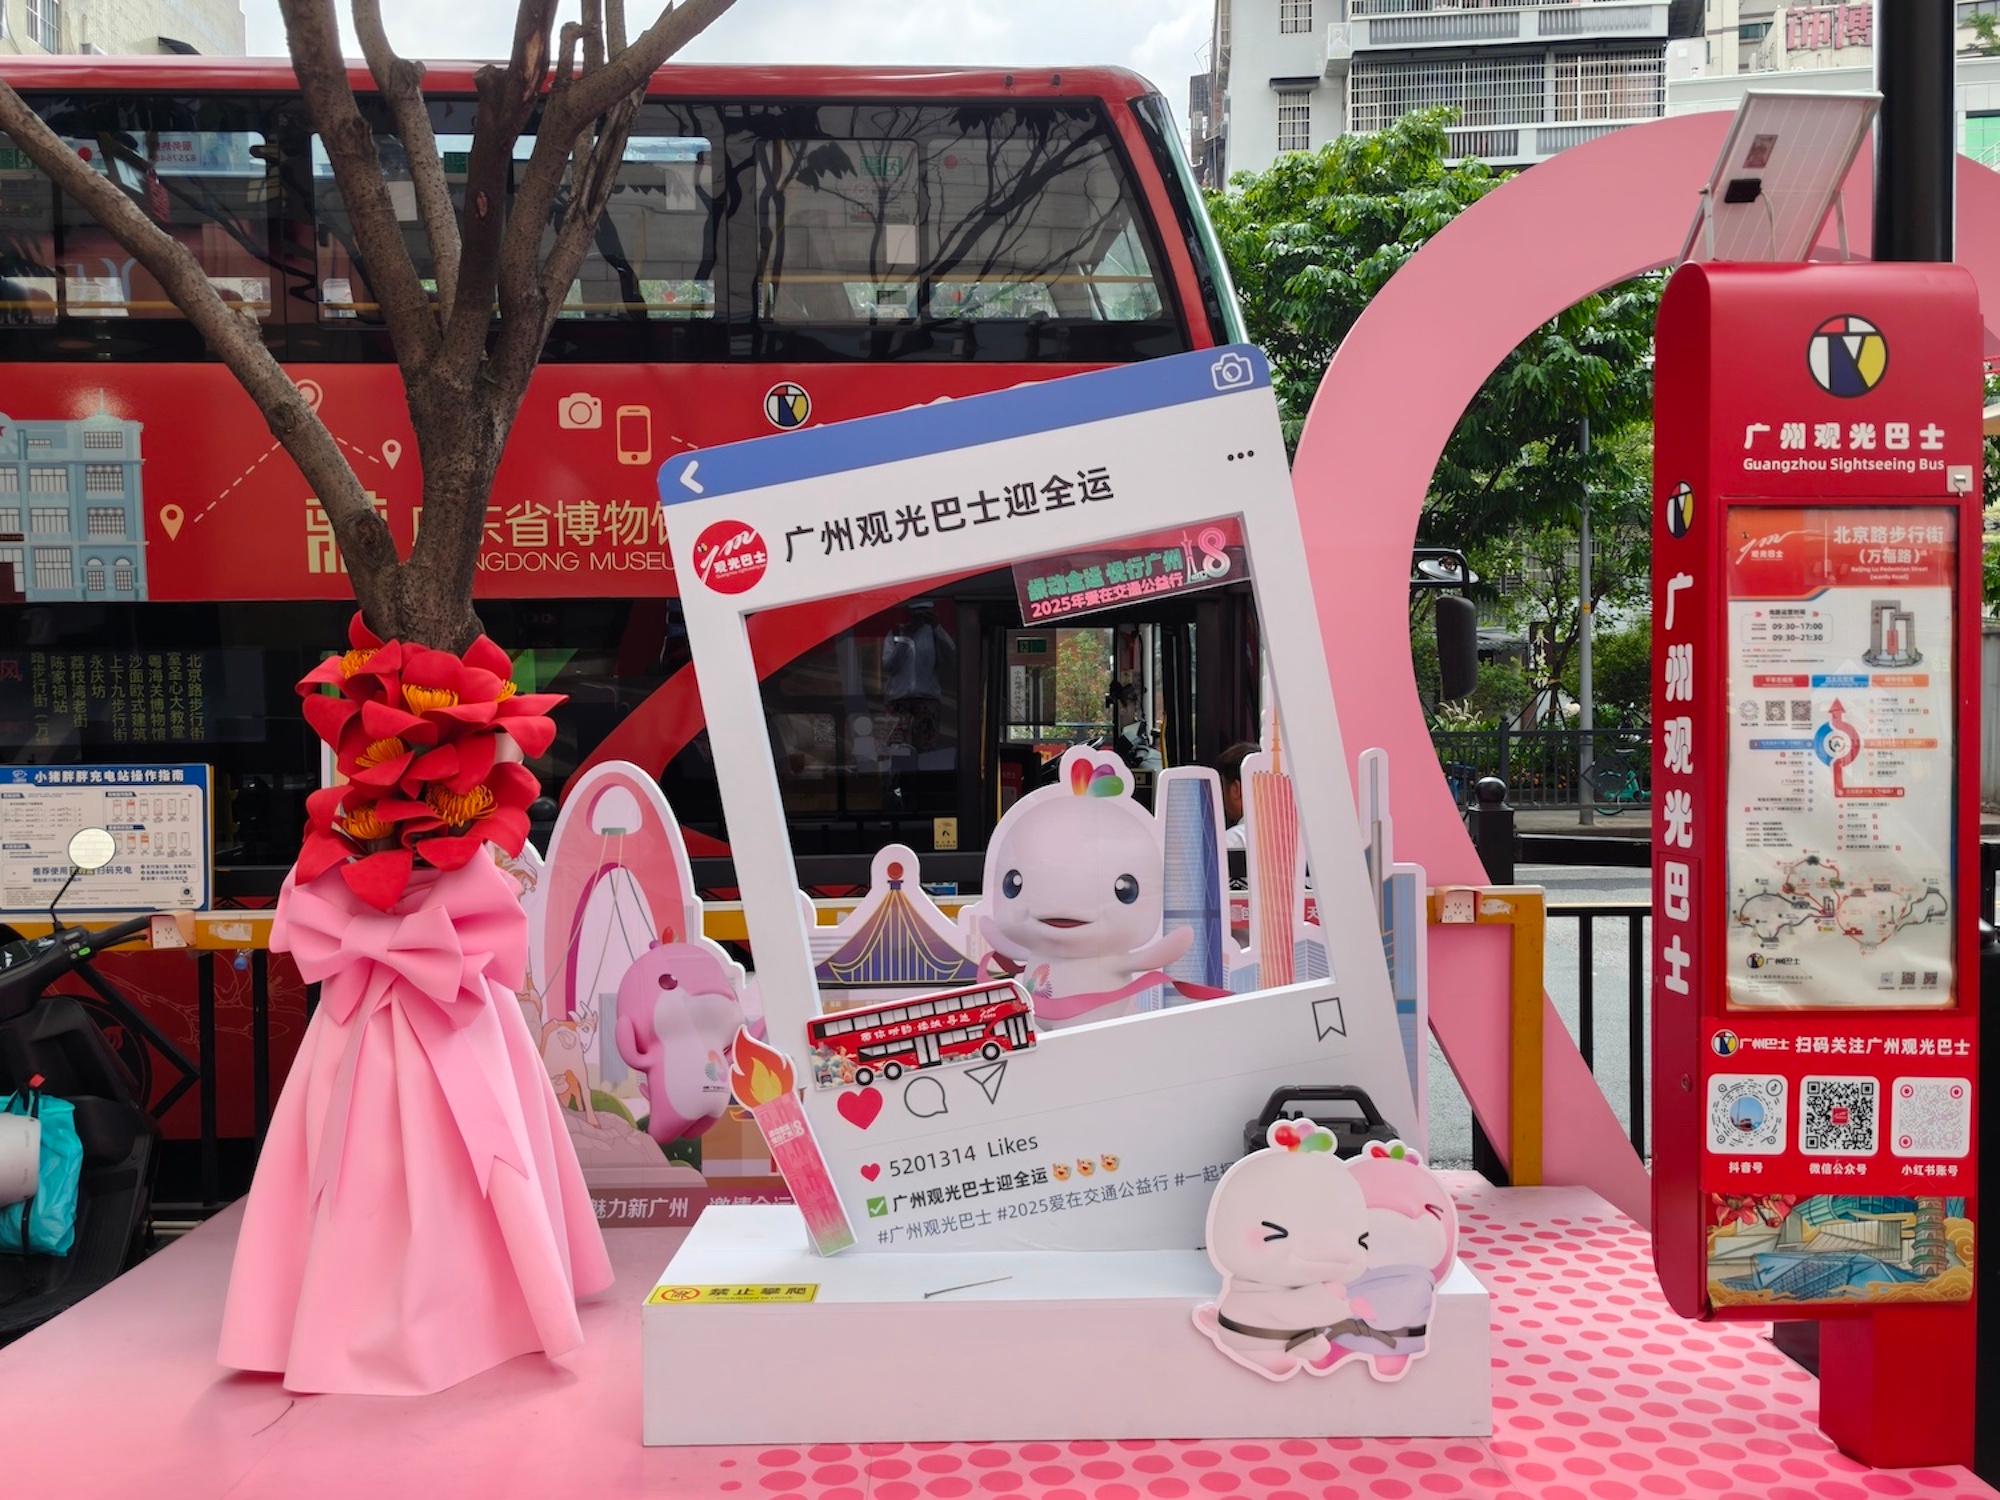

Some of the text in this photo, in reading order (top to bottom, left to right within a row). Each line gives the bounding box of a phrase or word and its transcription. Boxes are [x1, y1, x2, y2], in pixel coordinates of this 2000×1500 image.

[1743, 422, 1945, 450] 广州观光巴士
[1743, 457, 1945, 474] Guangzhou Sightseeing Bus
[784, 466, 1115, 563] 广州观光巴士迎全运
[1832, 526, 1945, 544] 北京路步行街
[713, 550, 766, 574] 观光巴士
[90, 654, 105, 699] 永庆坊
[110, 655, 127, 742] 上下九步行街
[187, 654, 205, 741] 北京路步行街
[34, 769, 185, 784] 小猪胖胖充电站操作指南
[1664, 572, 1694, 995] 广州观光巴士
[1739, 1036, 1970, 1056] 广州巴士 扫码关注广州观光巴士
[890, 1135, 1039, 1178] 5201314 Likes
[1728, 1162, 1763, 1175] 抖音号
[1809, 1163, 1867, 1176] 微信公众号
[1901, 1164, 1959, 1177] 小红书账号
[892, 1166, 1049, 1213] 广州观光巴士迎全运
[877, 1173, 1170, 1244] #广州观光巴士 #2025爱在交通公益行
